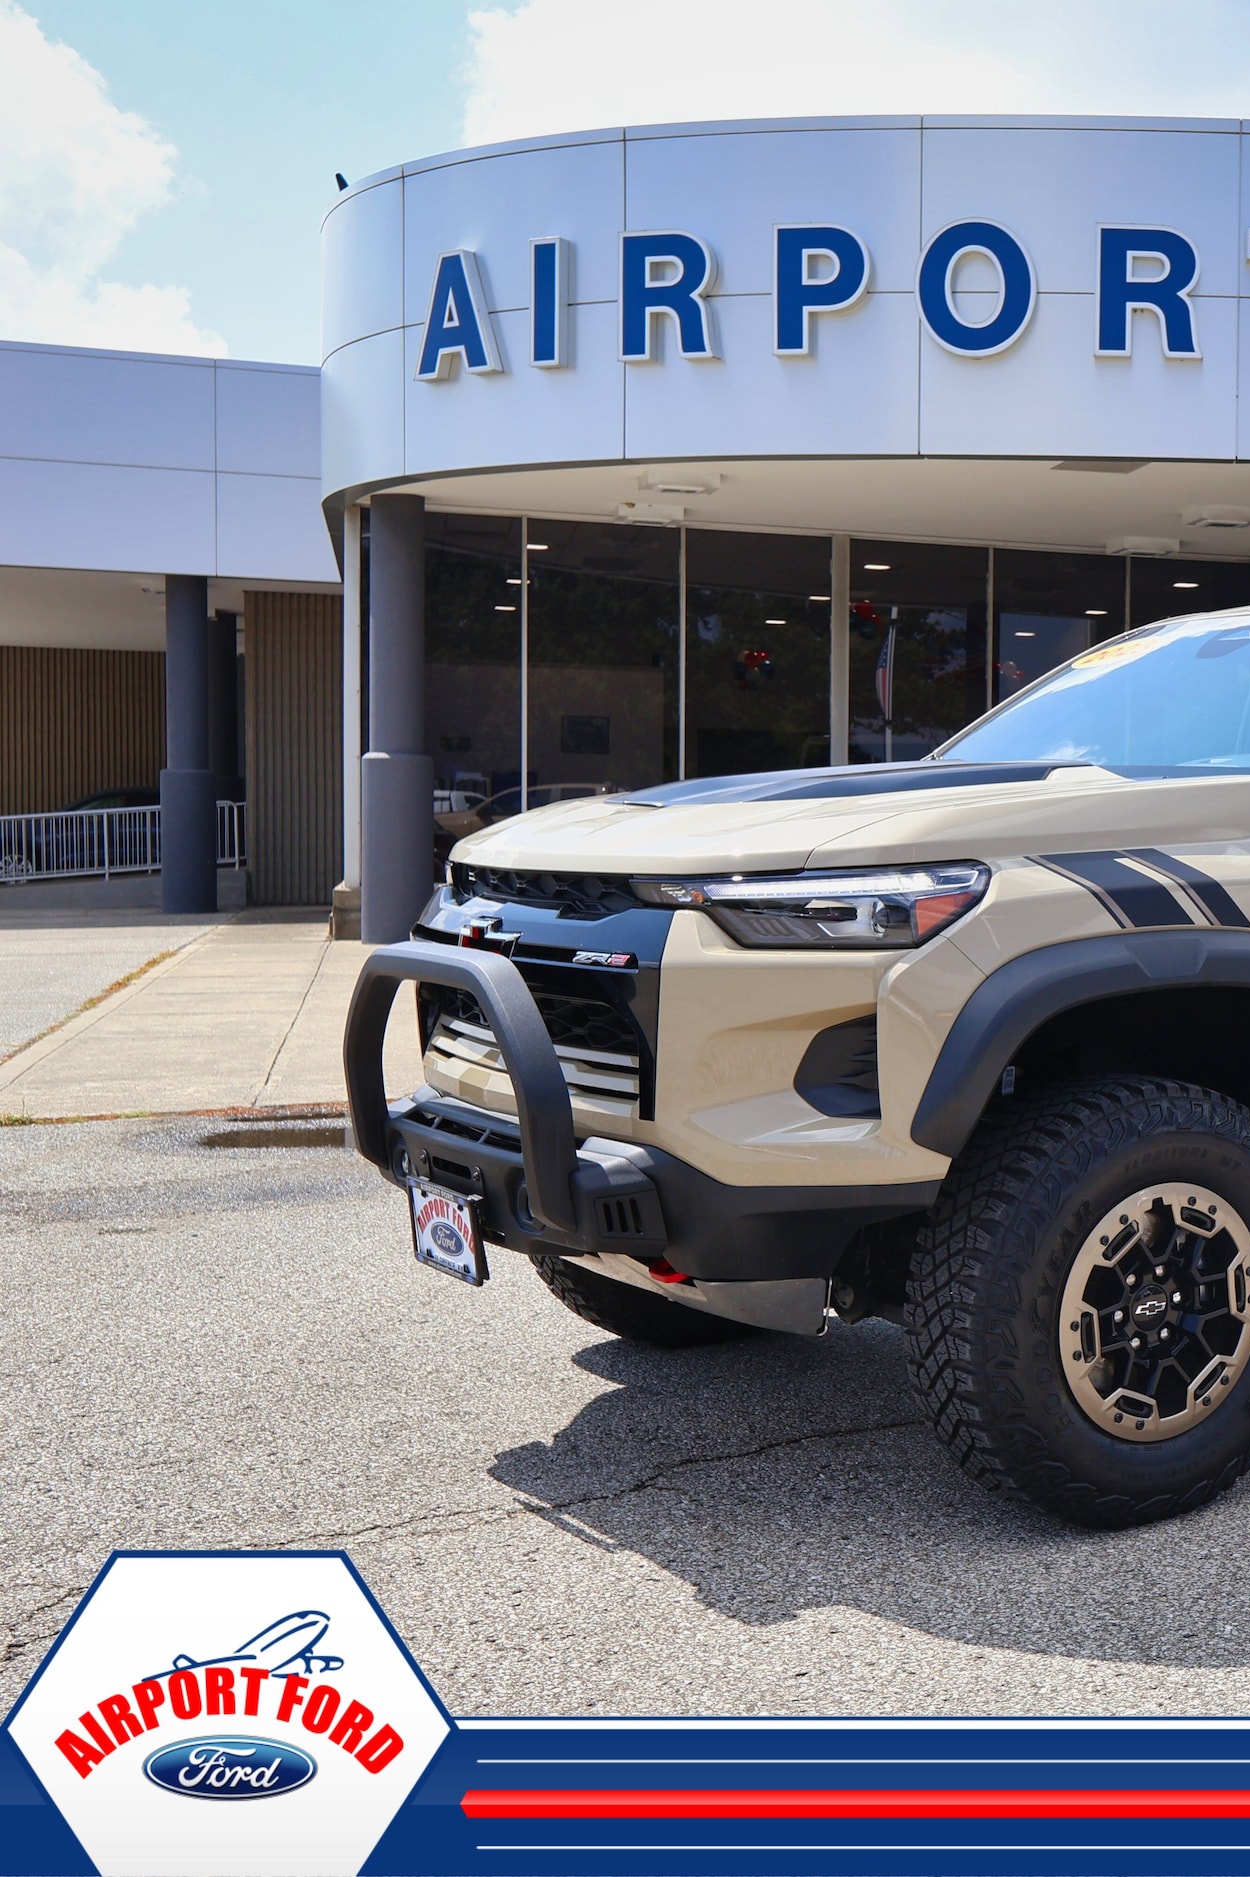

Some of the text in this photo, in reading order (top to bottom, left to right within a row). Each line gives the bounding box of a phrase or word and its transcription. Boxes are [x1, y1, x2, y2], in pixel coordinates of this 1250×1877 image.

[572, 951, 631, 967] ZR2
[417, 1198, 475, 1254] AIRPORT FORD
[436, 1226, 457, 1252] Ford
